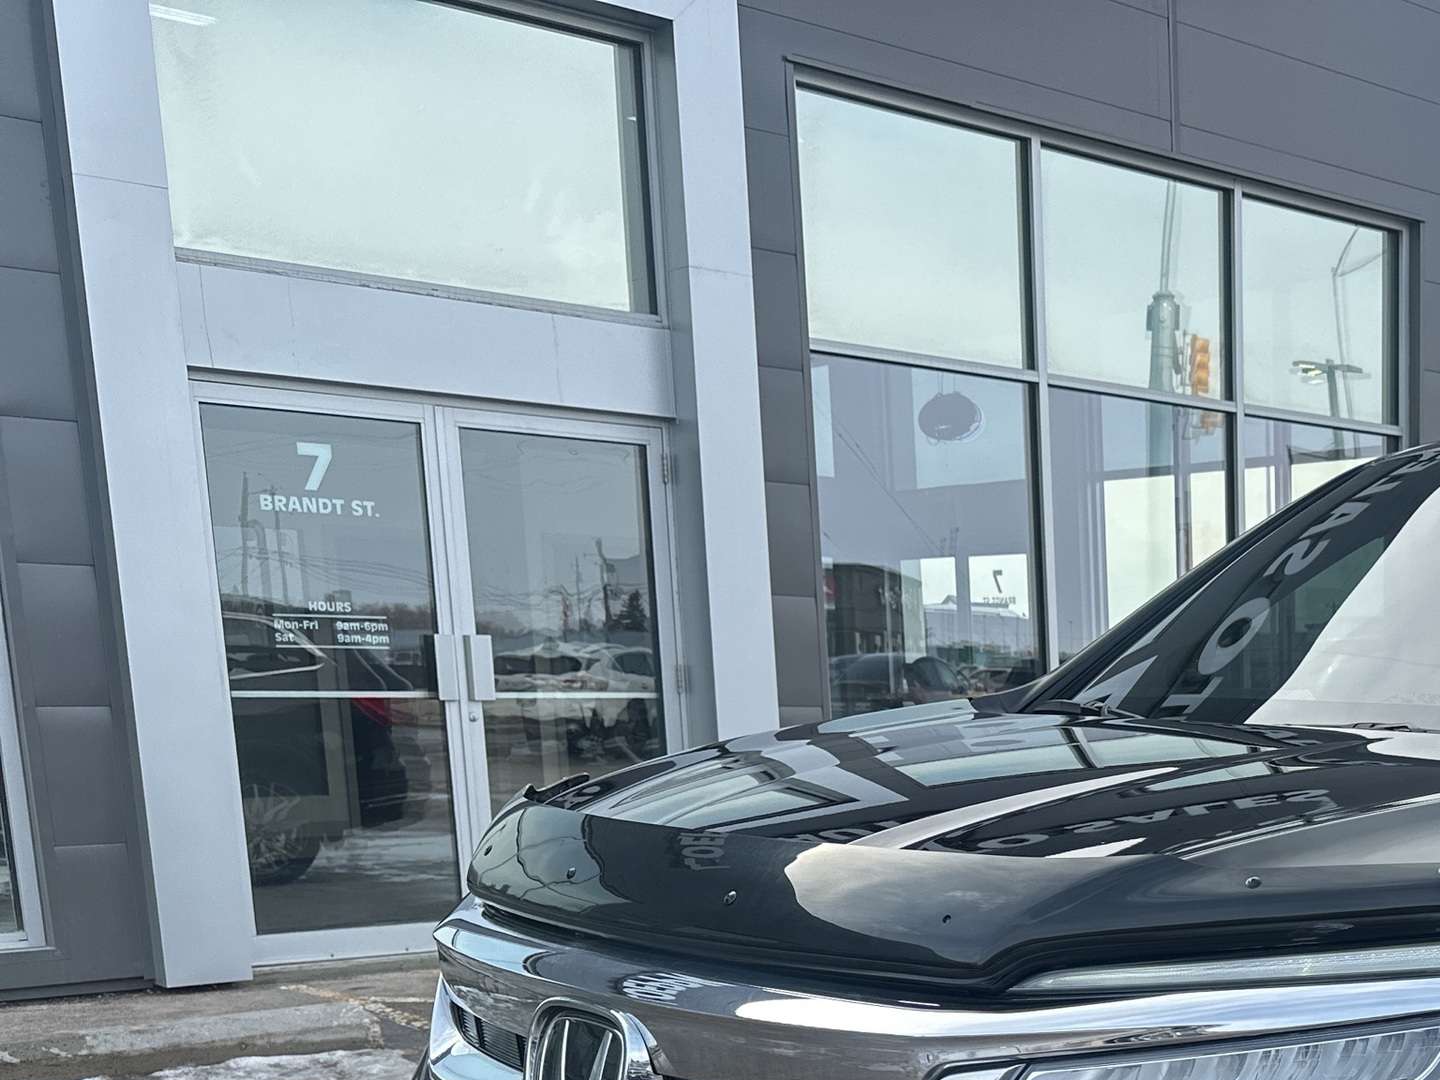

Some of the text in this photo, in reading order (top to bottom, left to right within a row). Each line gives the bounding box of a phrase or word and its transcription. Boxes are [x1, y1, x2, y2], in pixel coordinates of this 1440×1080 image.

[296, 441, 332, 491] 7
[259, 494, 380, 517] BRANDT ST.
[308, 601, 352, 613] HOURS
[273, 619, 319, 630] Mon-Fri
[275, 632, 390, 645] Sat 9am-4pm
